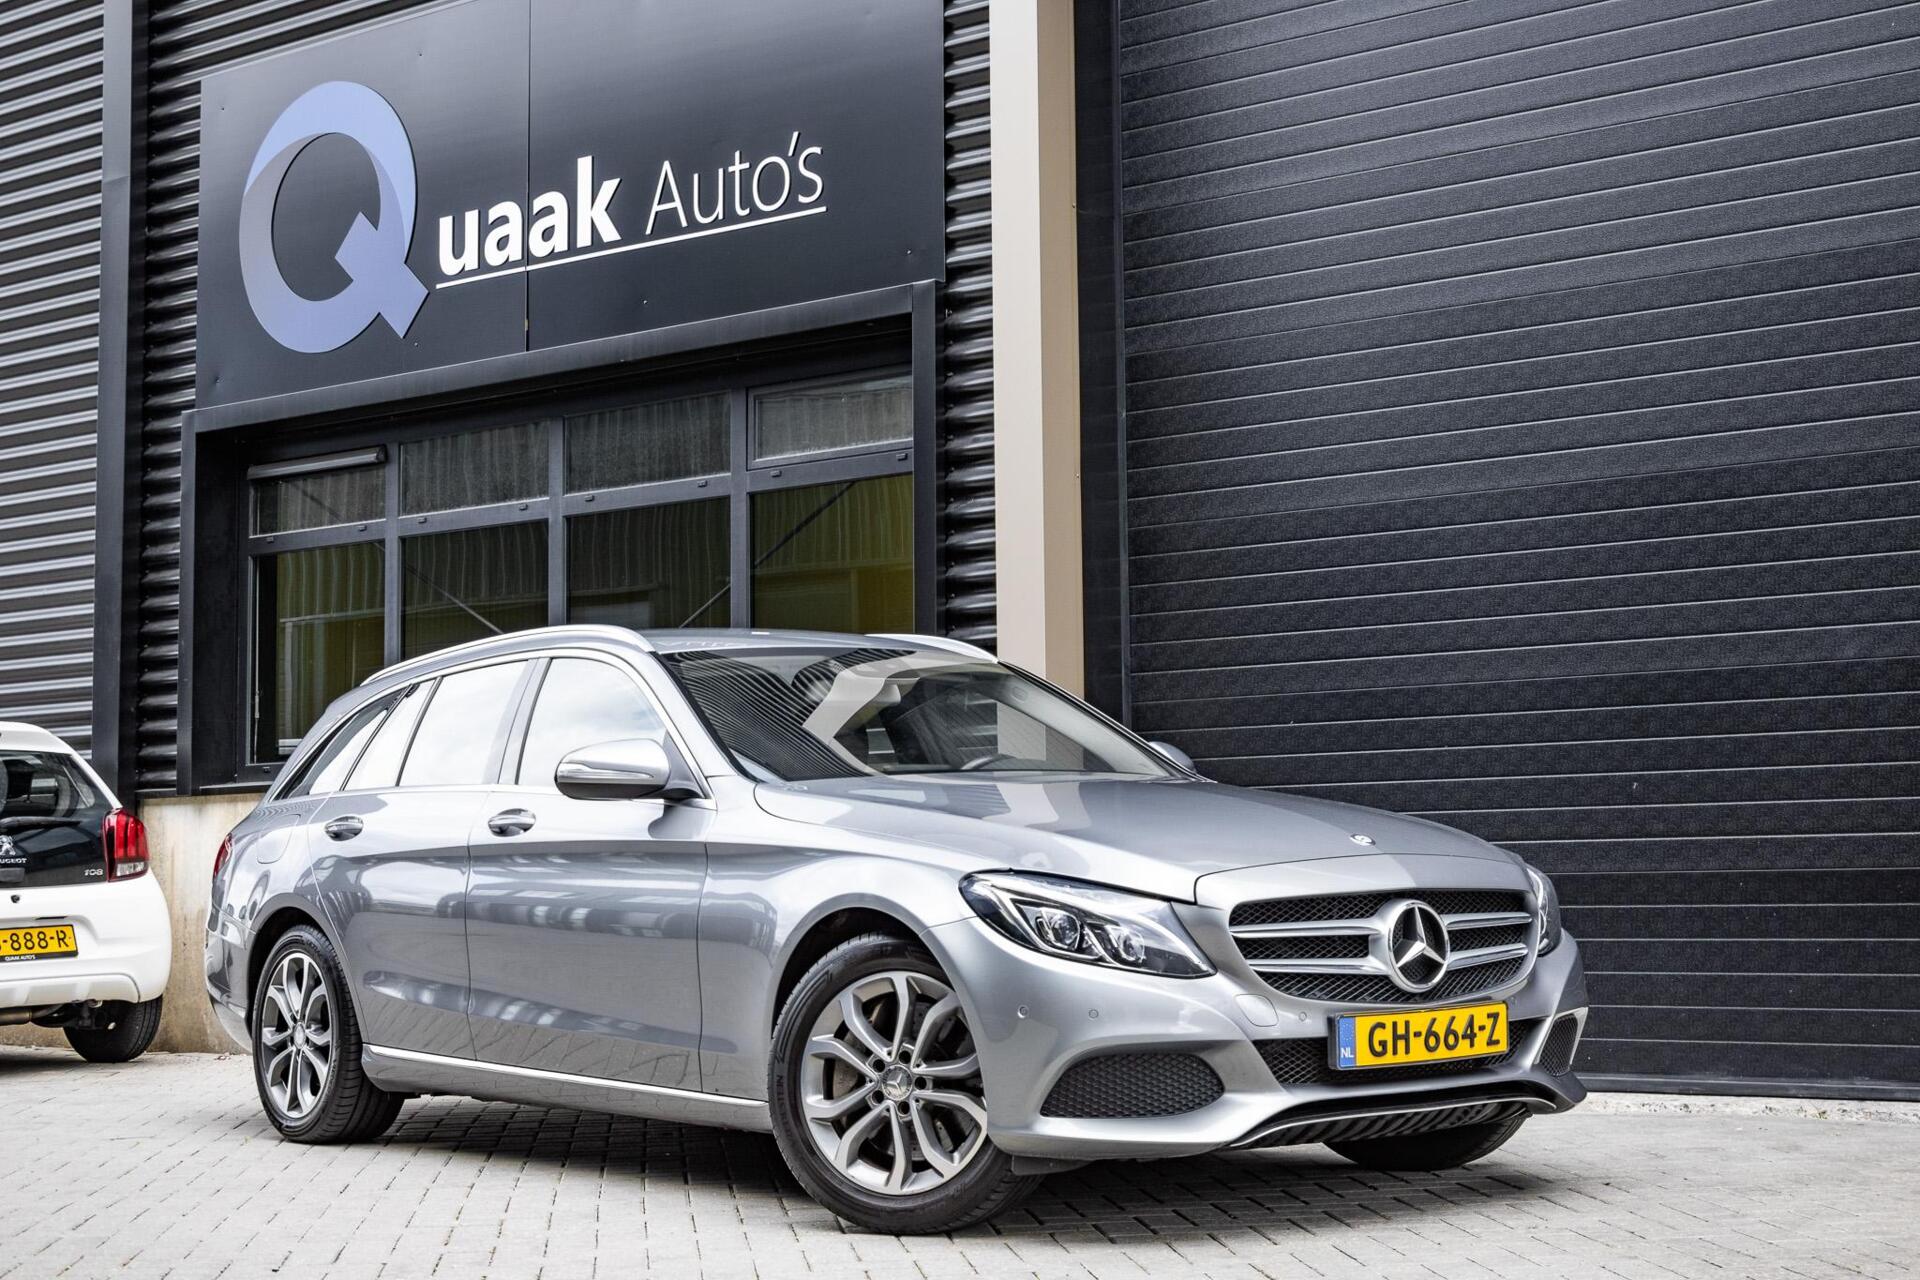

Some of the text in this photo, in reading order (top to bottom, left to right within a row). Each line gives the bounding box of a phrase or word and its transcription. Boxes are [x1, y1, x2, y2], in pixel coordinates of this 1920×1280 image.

[645, 131, 825, 235] Auto's
[0, 930, 69, 951] -888-R
[1368, 1012, 1500, 1057] GH-664-Z
[1340, 1048, 1354, 1058] NL
